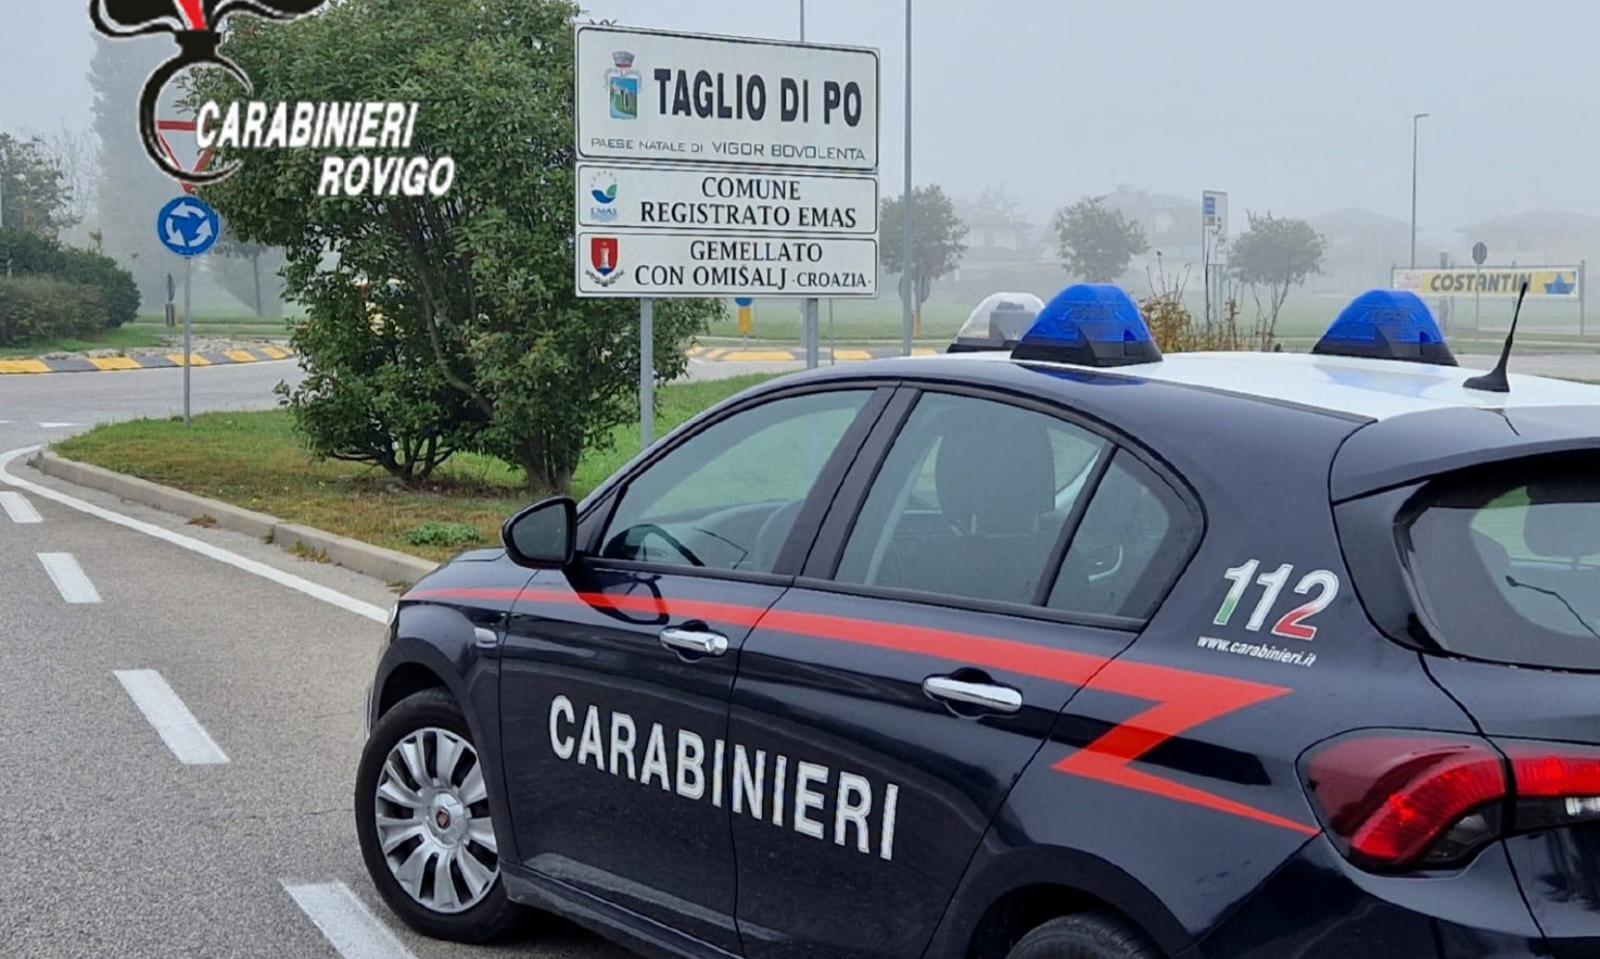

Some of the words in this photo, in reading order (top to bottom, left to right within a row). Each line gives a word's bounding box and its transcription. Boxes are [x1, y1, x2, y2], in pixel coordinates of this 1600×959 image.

[654, 68, 766, 121] TAGLIO
[780, 77, 809, 123] DI
[823, 80, 862, 127] PO
[591, 137, 633, 150] PAESE
[639, 140, 685, 152] NATALE
[712, 141, 764, 157] VIGOR
[771, 144, 865, 160] BOVOLENTA
[701, 176, 801, 200] COMUNE
[640, 201, 790, 226] REGISTRATO
[799, 207, 857, 228] EMAS
[690, 240, 823, 262] GEMELLATO
[635, 265, 685, 286] CON
[1430, 273, 1532, 292] COSTANTIN
[1213, 558, 1340, 641] 112
[1197, 635, 1317, 667] www.carabinieri.it
[549, 694, 899, 861] CARABINIERI
